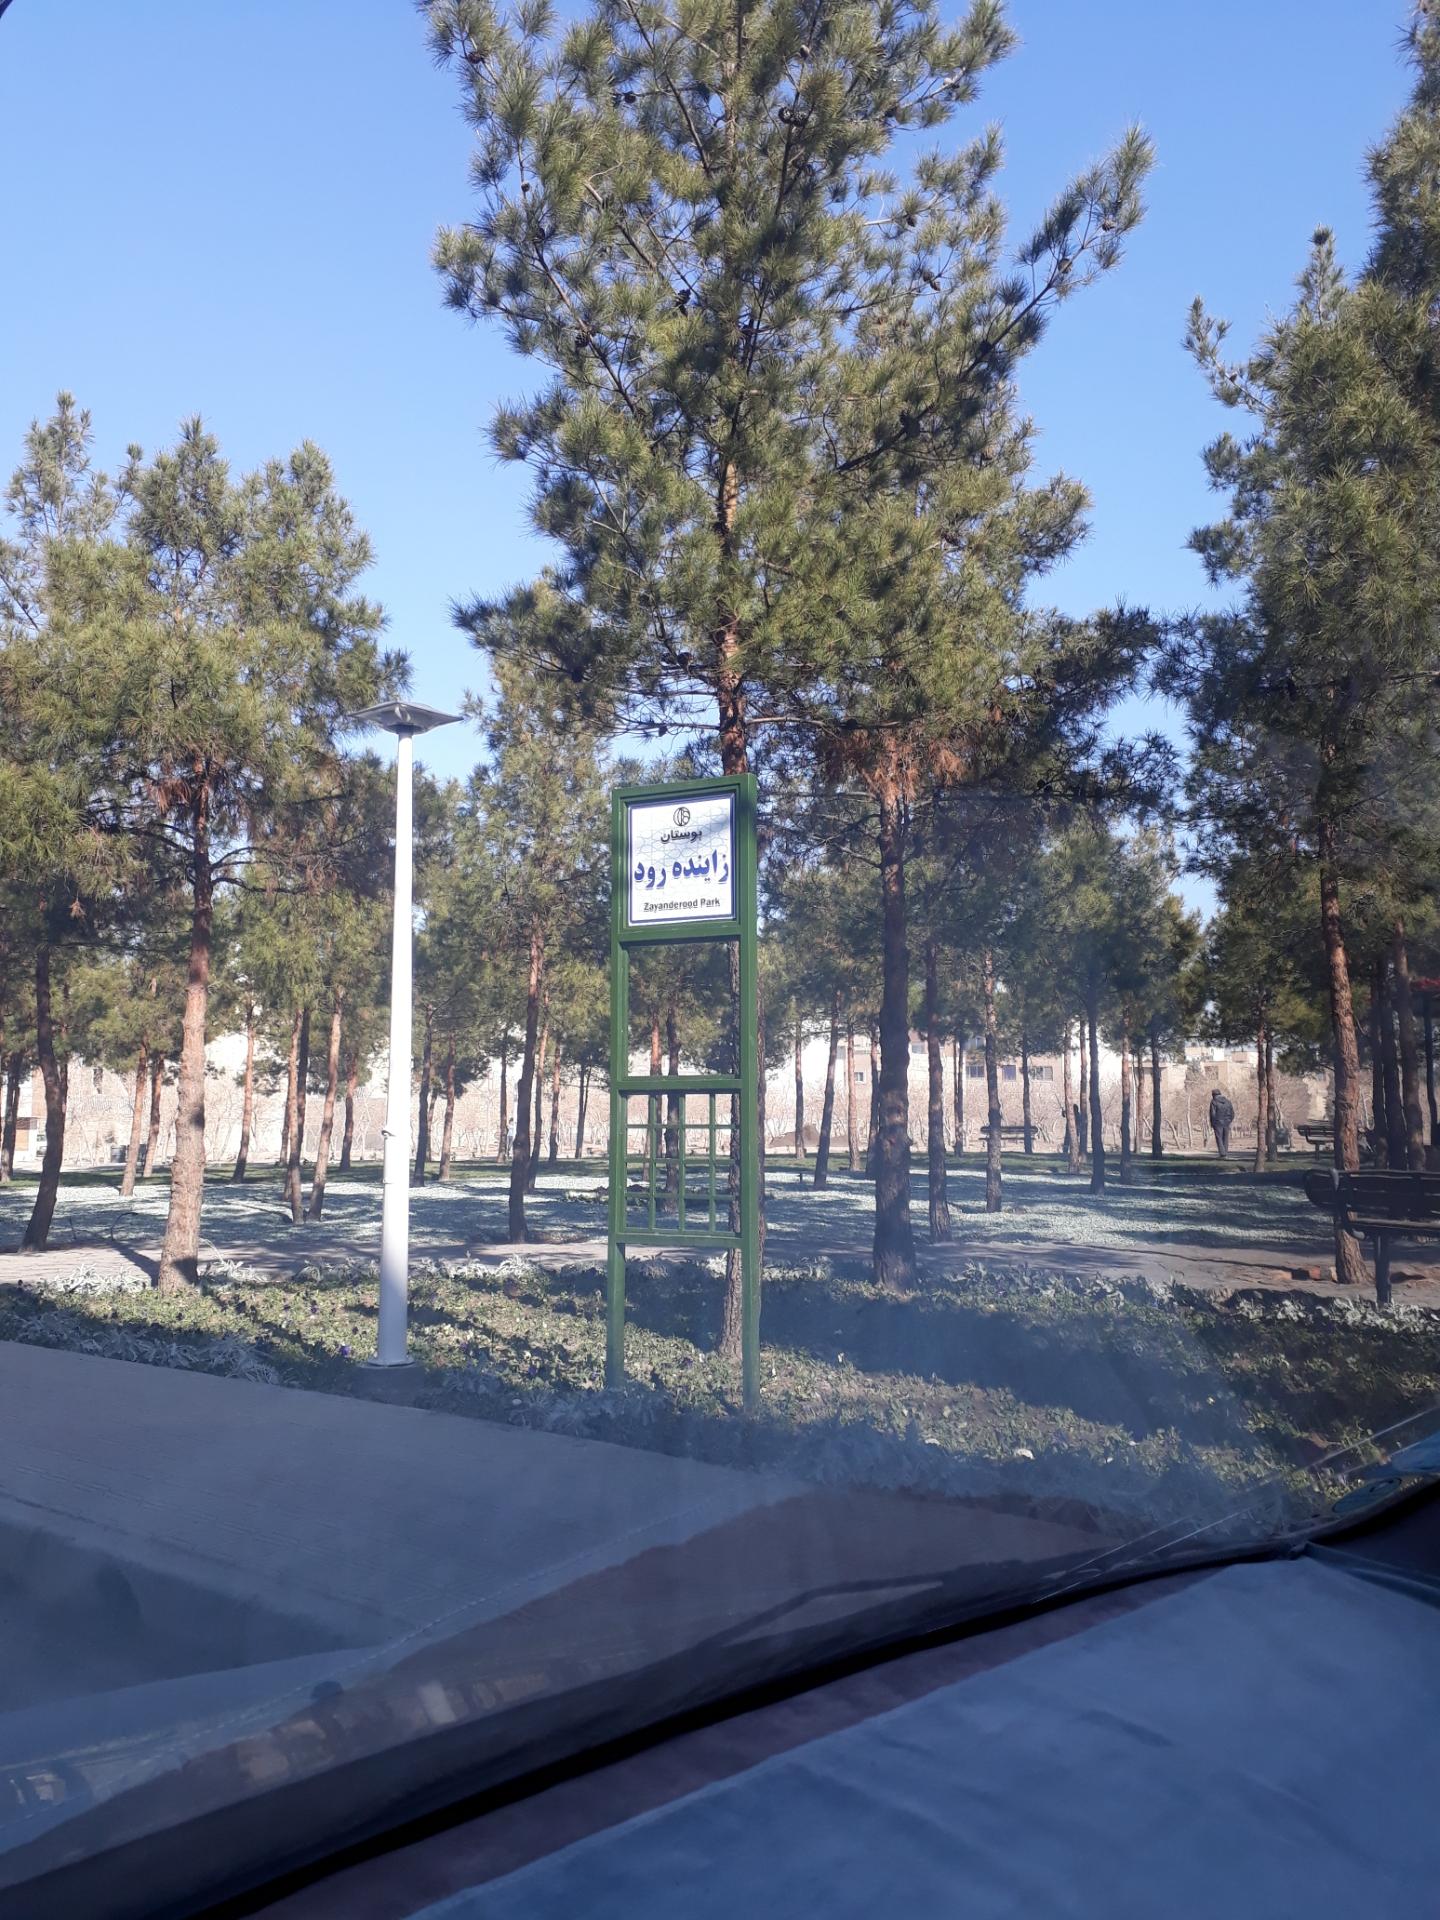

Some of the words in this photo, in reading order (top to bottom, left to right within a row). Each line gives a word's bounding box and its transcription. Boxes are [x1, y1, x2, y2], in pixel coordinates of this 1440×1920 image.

[660, 829, 702, 844] بوستان
[634, 861, 666, 890] رود
[672, 849, 729, 884] زاینده
[643, 899, 698, 912] Zayanderood
[701, 897, 720, 907] Park
